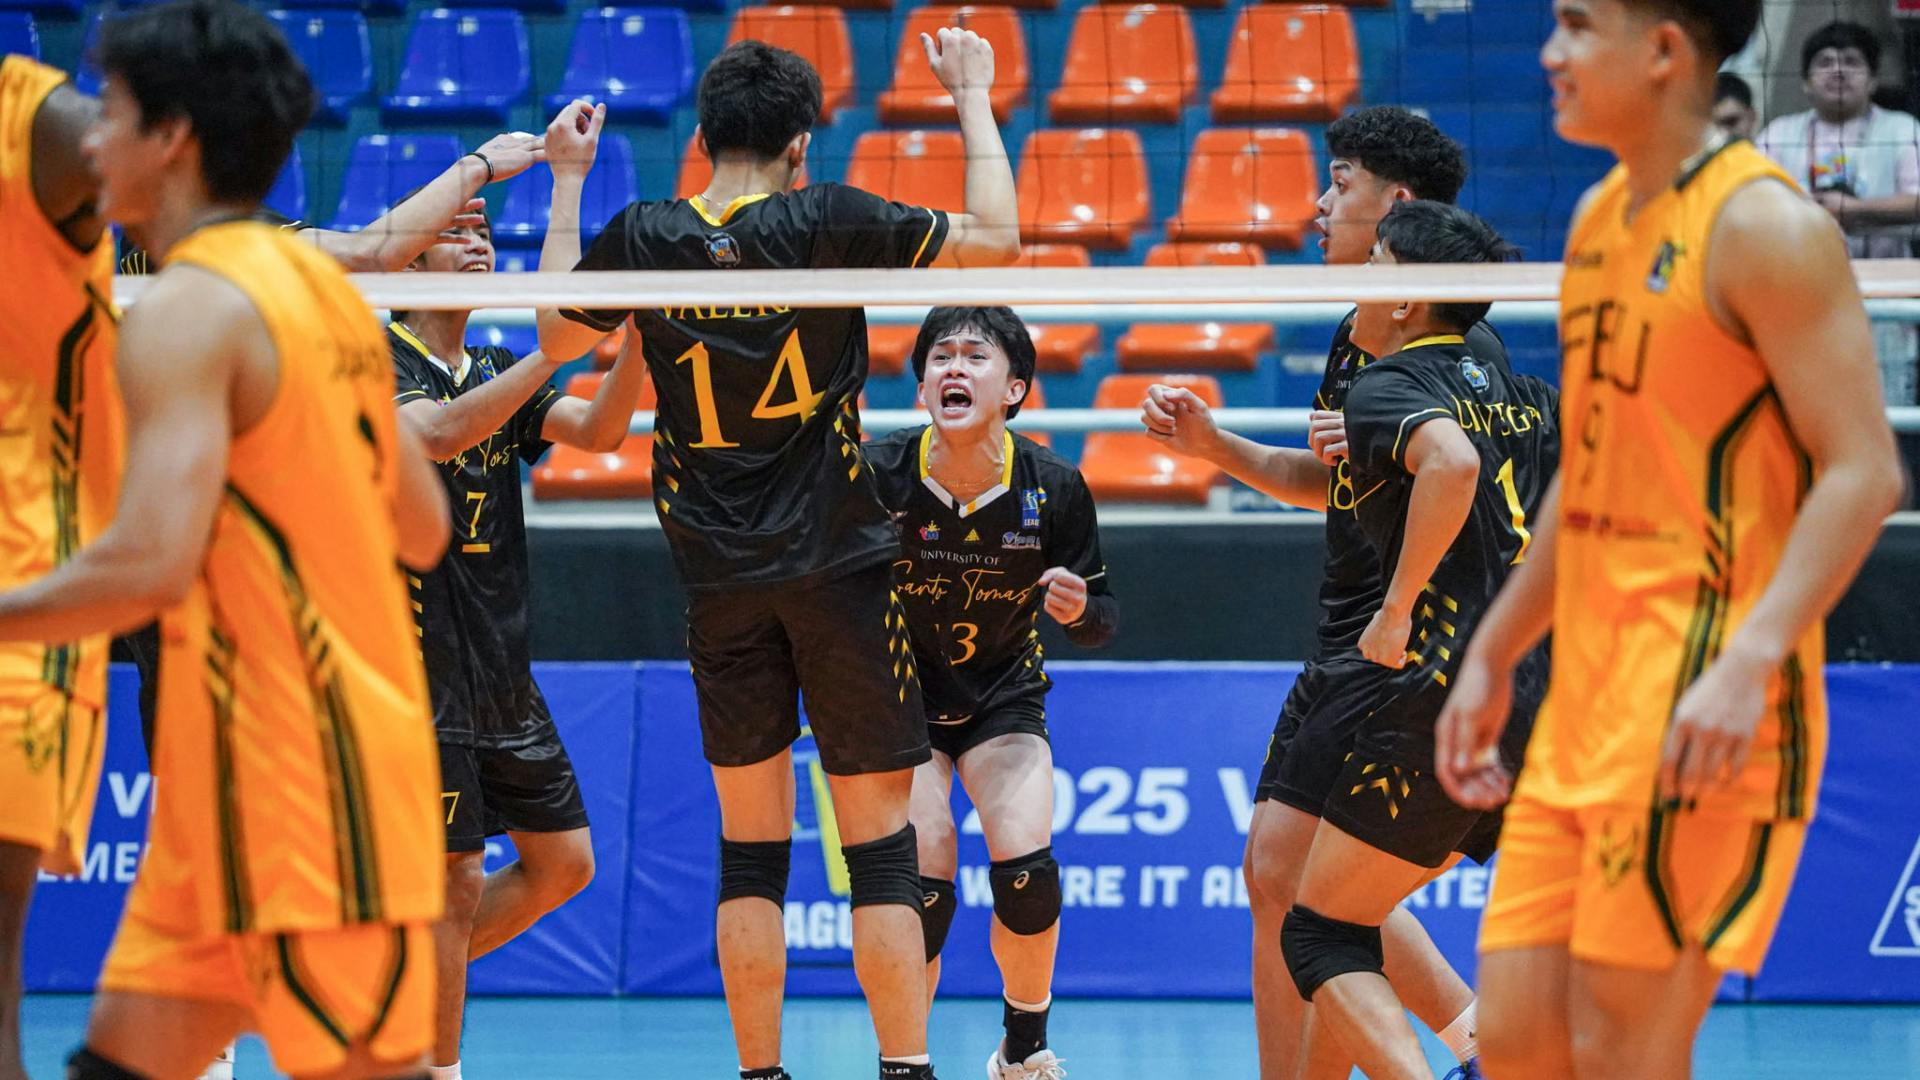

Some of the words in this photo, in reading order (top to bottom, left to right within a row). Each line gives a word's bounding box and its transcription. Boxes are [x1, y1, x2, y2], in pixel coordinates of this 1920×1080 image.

[675, 327, 827, 449] 14
[466, 491, 487, 539] 7
[920, 549, 981, 564] UNIVERSITY
[984, 556, 1001, 566] OF
[962, 568, 1037, 610] Tomas
[935, 622, 979, 667] 3
[440, 791, 460, 825] 7
[959, 865, 1126, 908] WRE
[1139, 865, 1190, 908] IT
